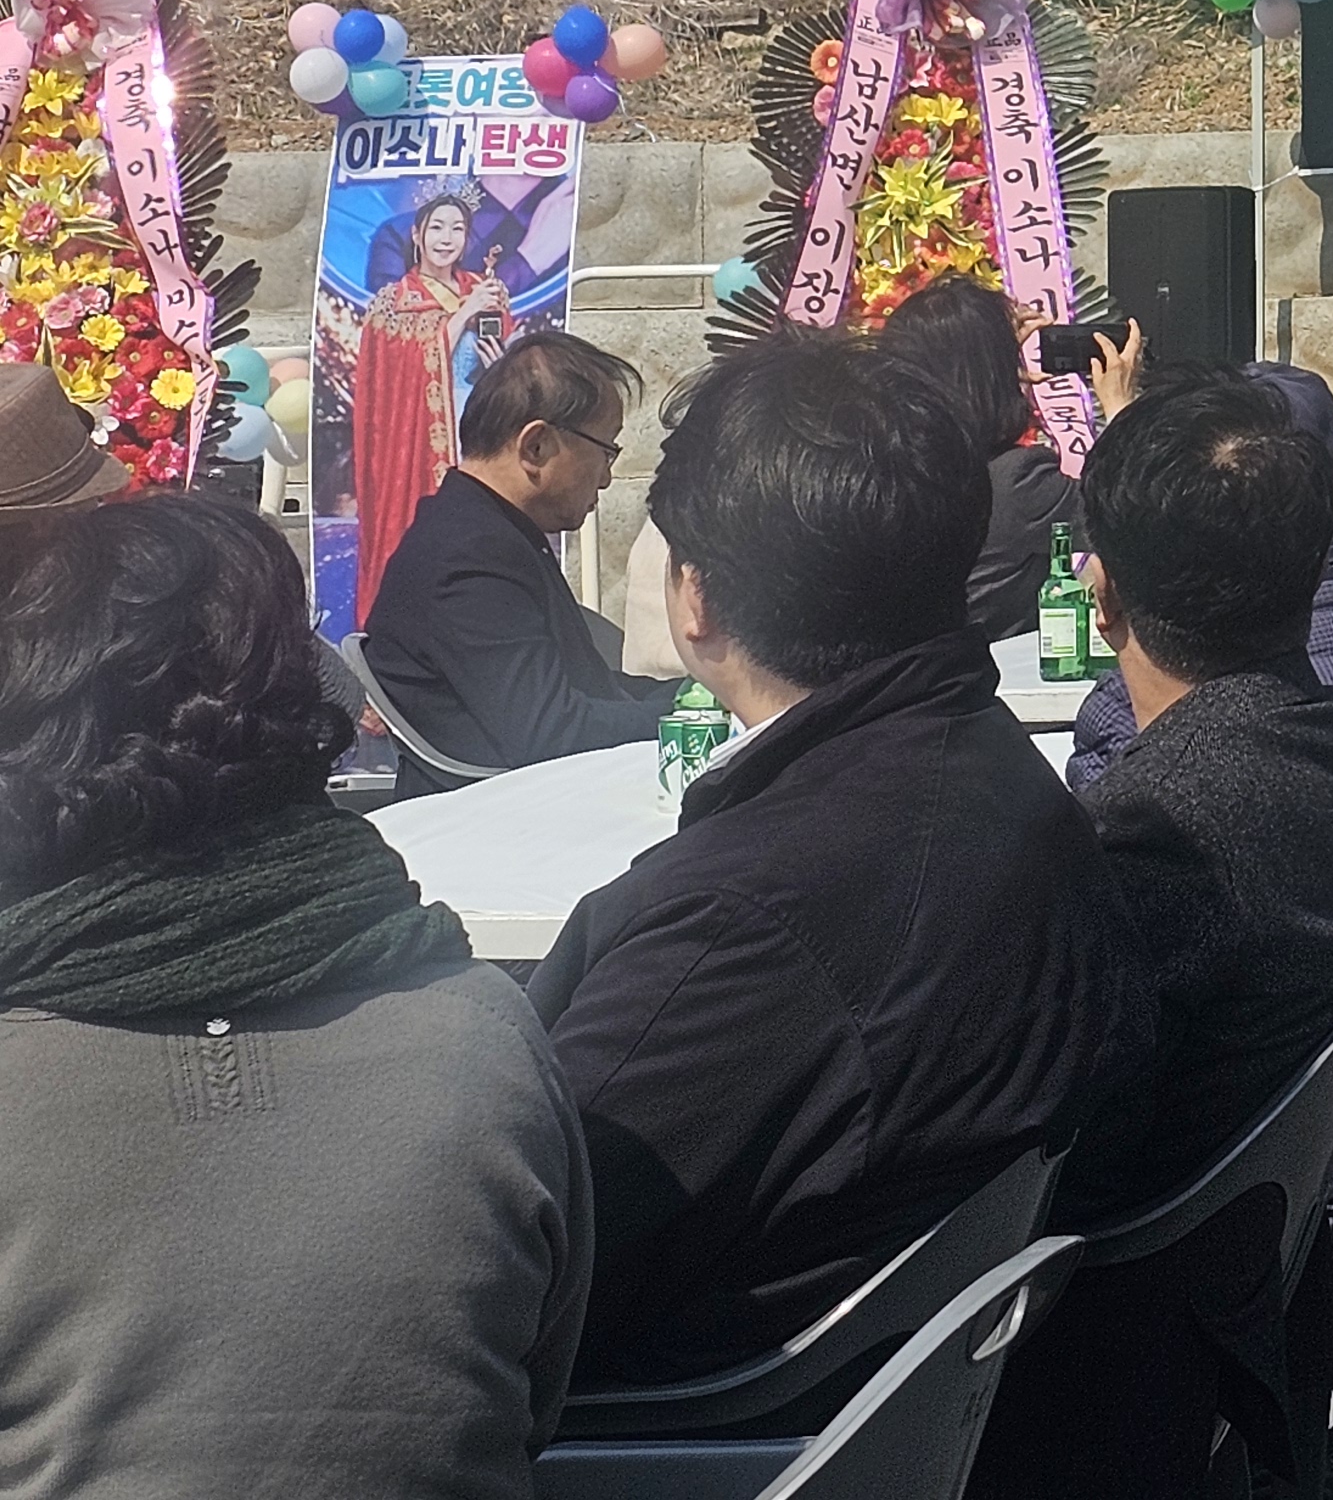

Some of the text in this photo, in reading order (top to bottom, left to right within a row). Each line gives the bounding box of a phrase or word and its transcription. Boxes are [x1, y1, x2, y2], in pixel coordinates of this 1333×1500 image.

[399, 66, 536, 109] 롯여왕
[830, 57, 889, 191] 남산면
[991, 72, 1039, 144] 경축
[345, 122, 568, 172] 이소나 탄생
[127, 148, 179, 264] 이소나
[1003, 158, 1060, 271] 이소나
[792, 219, 846, 326] 이장
